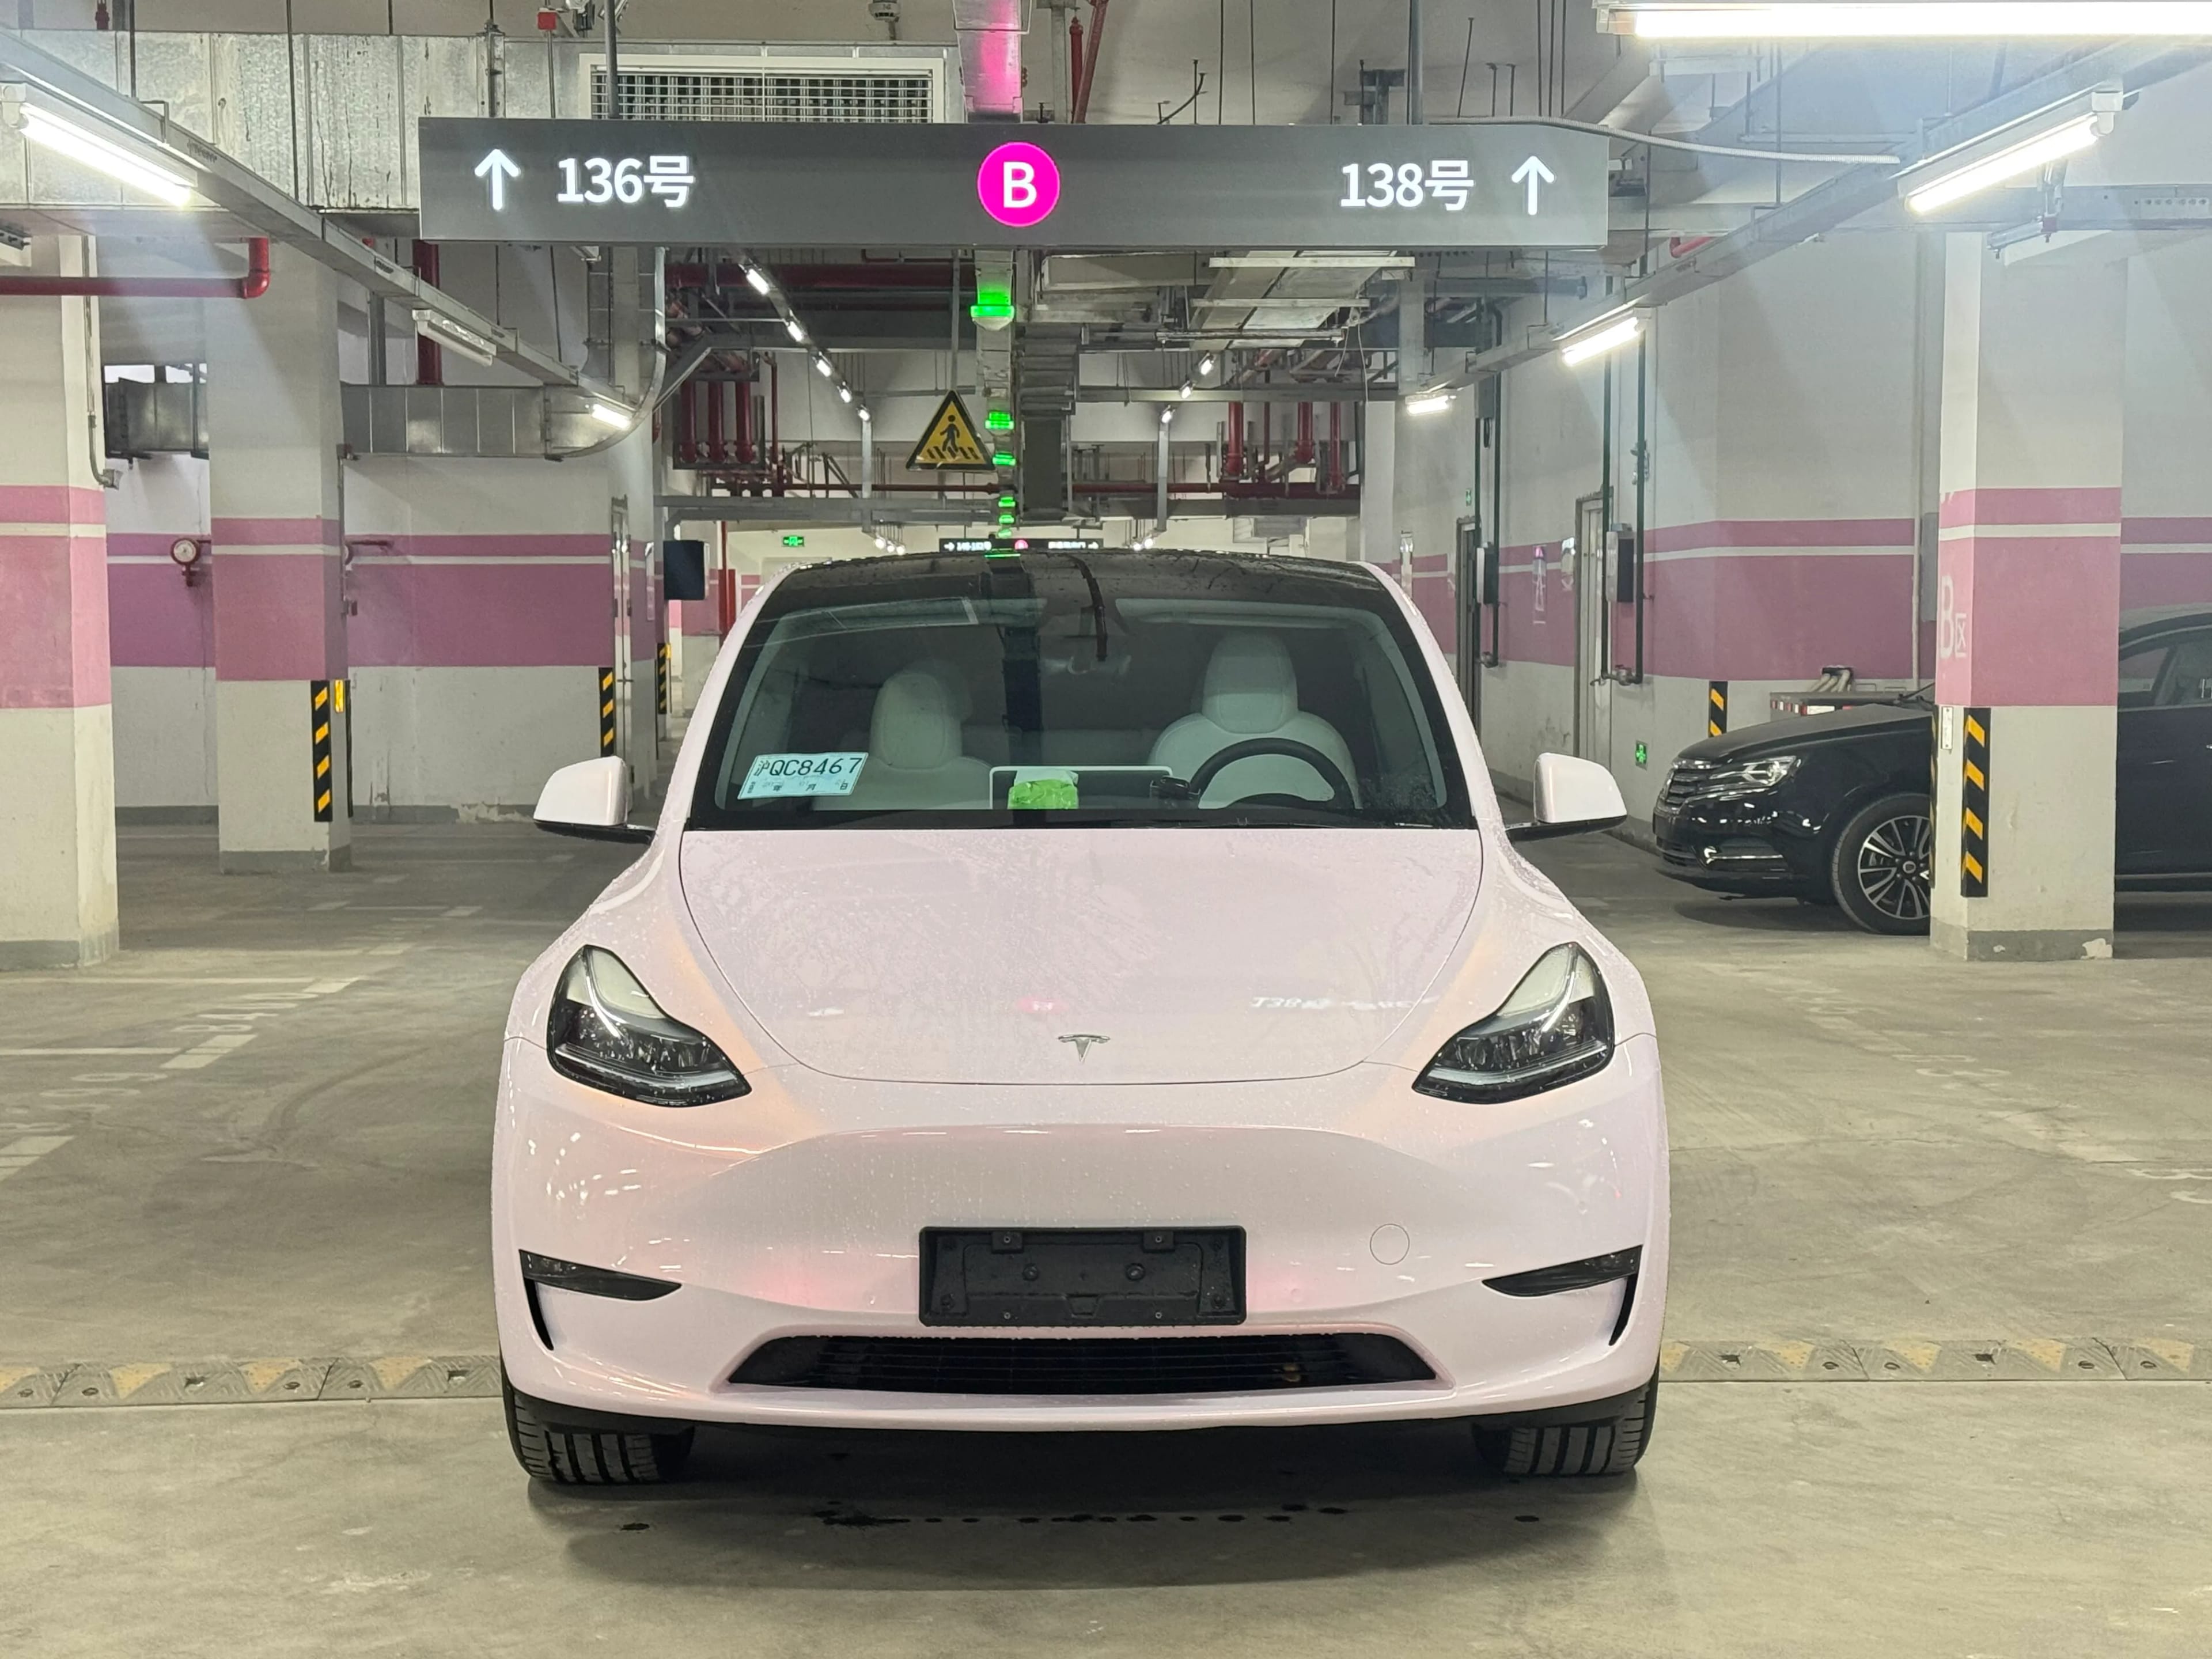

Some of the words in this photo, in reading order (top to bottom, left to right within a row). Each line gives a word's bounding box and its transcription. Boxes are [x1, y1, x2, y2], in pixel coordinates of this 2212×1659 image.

[557, 155, 695, 208] 136号
[1003, 161, 1036, 207] B
[1340, 160, 1475, 211] 138号
